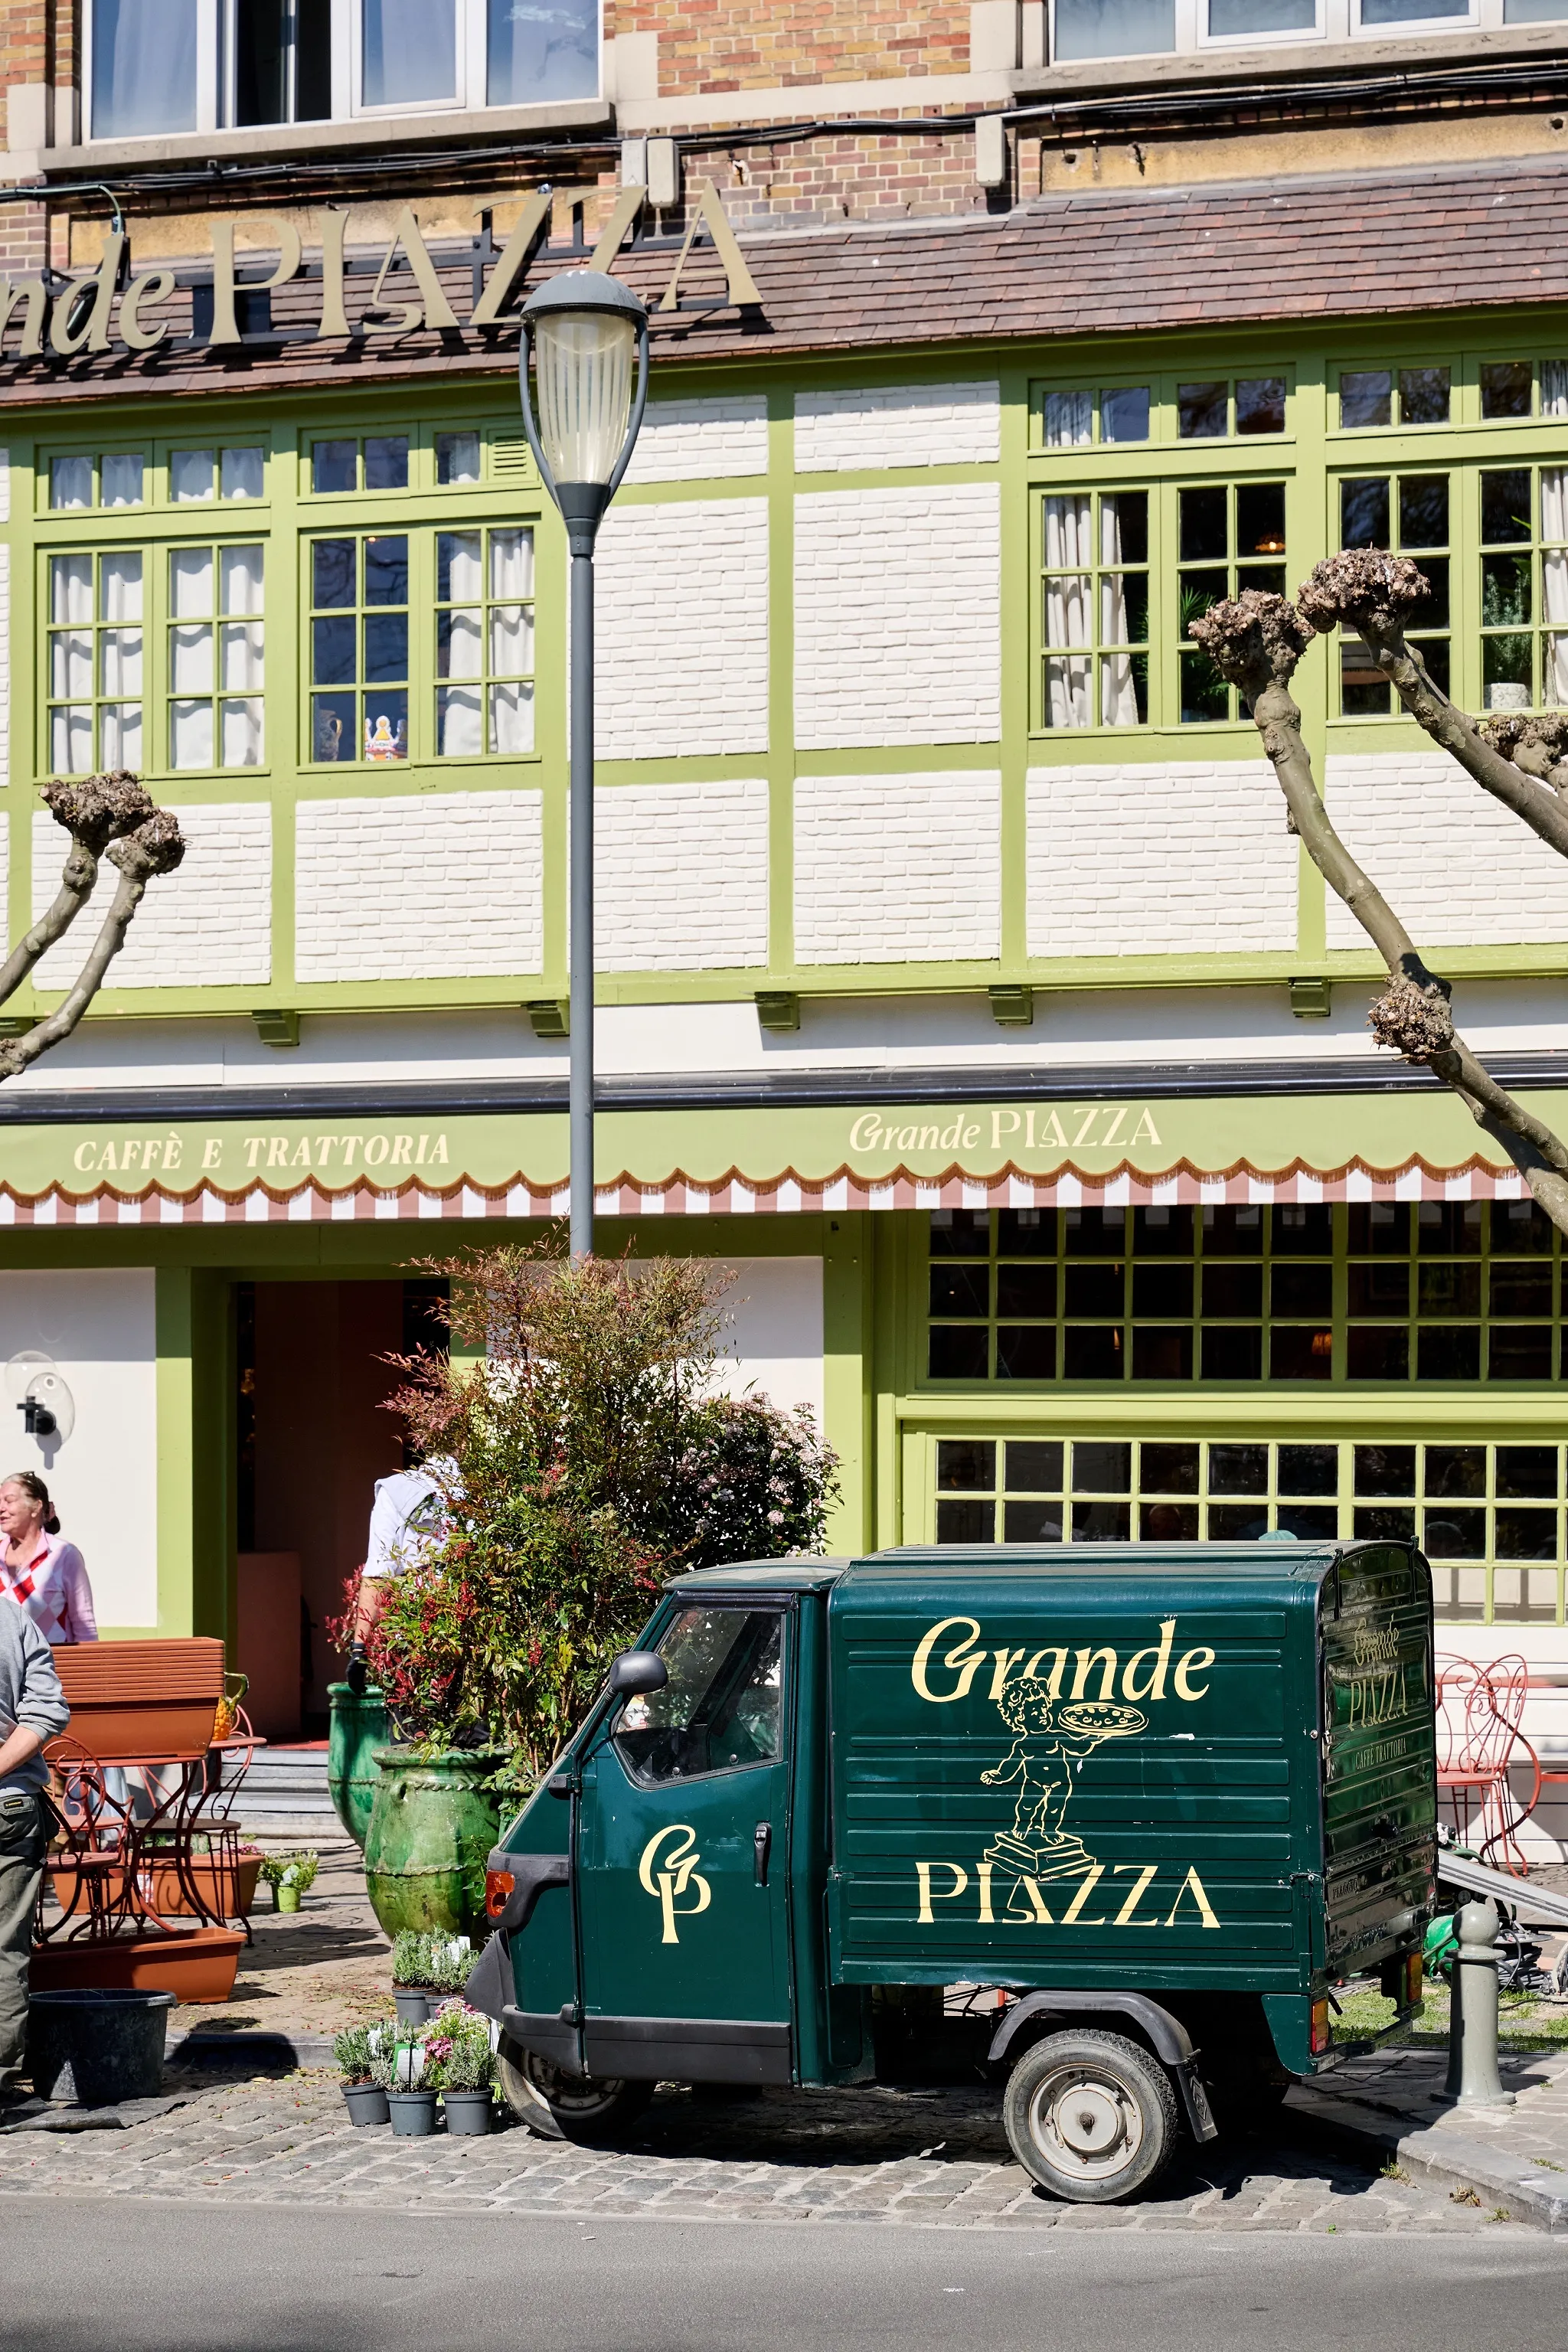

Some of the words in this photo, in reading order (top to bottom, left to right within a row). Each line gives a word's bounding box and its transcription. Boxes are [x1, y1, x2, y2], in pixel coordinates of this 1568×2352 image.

[74, 1131, 184, 1171] CAFFÈ
[201, 1138, 224, 1168] E
[243, 1133, 450, 1168] TRATTORIA
[849, 1112, 981, 1152] Grande
[990, 1107, 1162, 1148] PIAZZA
[911, 1616, 1216, 1703] Grande
[1354, 1613, 1400, 1666] Grande
[1348, 1661, 1408, 1732] PIAZZA
[1355, 1744, 1374, 1770] CAFFÈ
[1376, 1737, 1407, 1763] TRATTORIA
[915, 1861, 1221, 1929] PIAZZA
